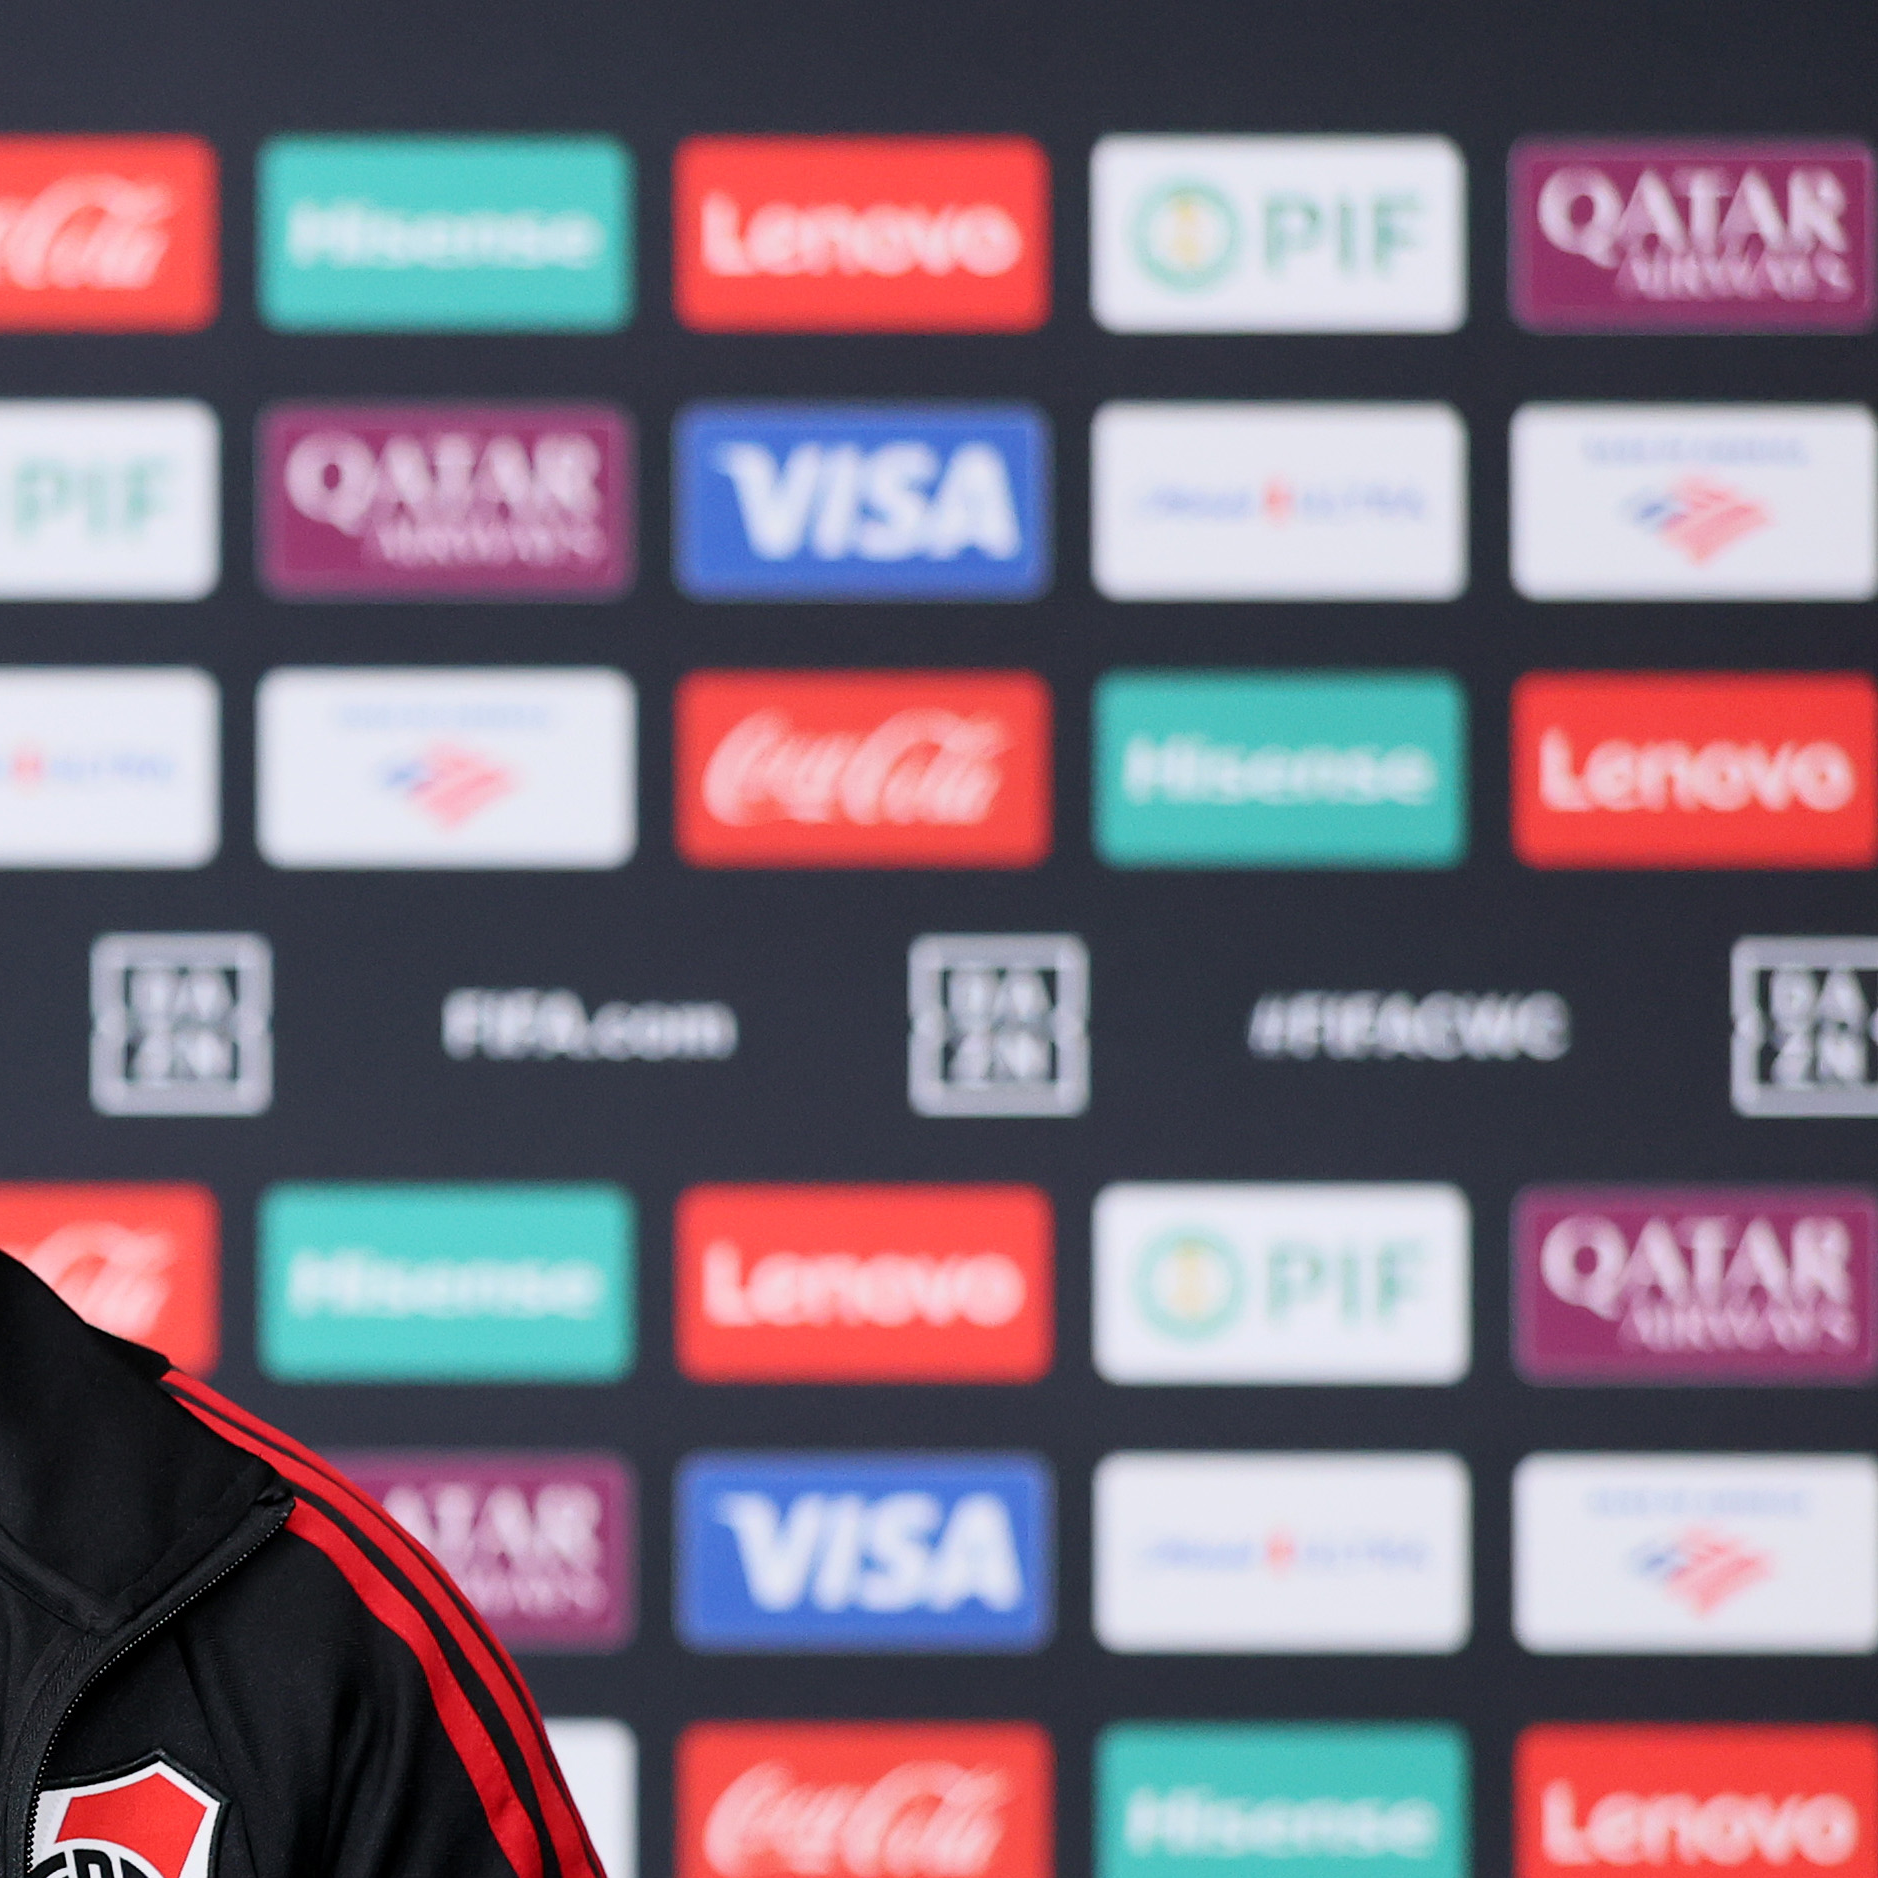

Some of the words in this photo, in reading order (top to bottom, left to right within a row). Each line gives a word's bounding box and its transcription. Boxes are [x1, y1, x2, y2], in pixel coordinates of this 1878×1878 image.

[701, 194, 1022, 276] Lenovo
[1261, 192, 1422, 273] PIF
[1538, 170, 1846, 269] QATAR
[9, 456, 170, 537] PIF
[285, 434, 598, 538] QATAR
[720, 442, 1020, 561] VISA
[1539, 729, 1855, 812] Lenovo
[702, 1243, 1025, 1326] Lenovo
[1265, 1241, 1421, 1320] PIF
[1541, 1218, 1851, 1324] QATAR
[383, 1482, 603, 1573] ATAR
[721, 1492, 1022, 1612] VISA
[1541, 1782, 1858, 1865] Lenovo
